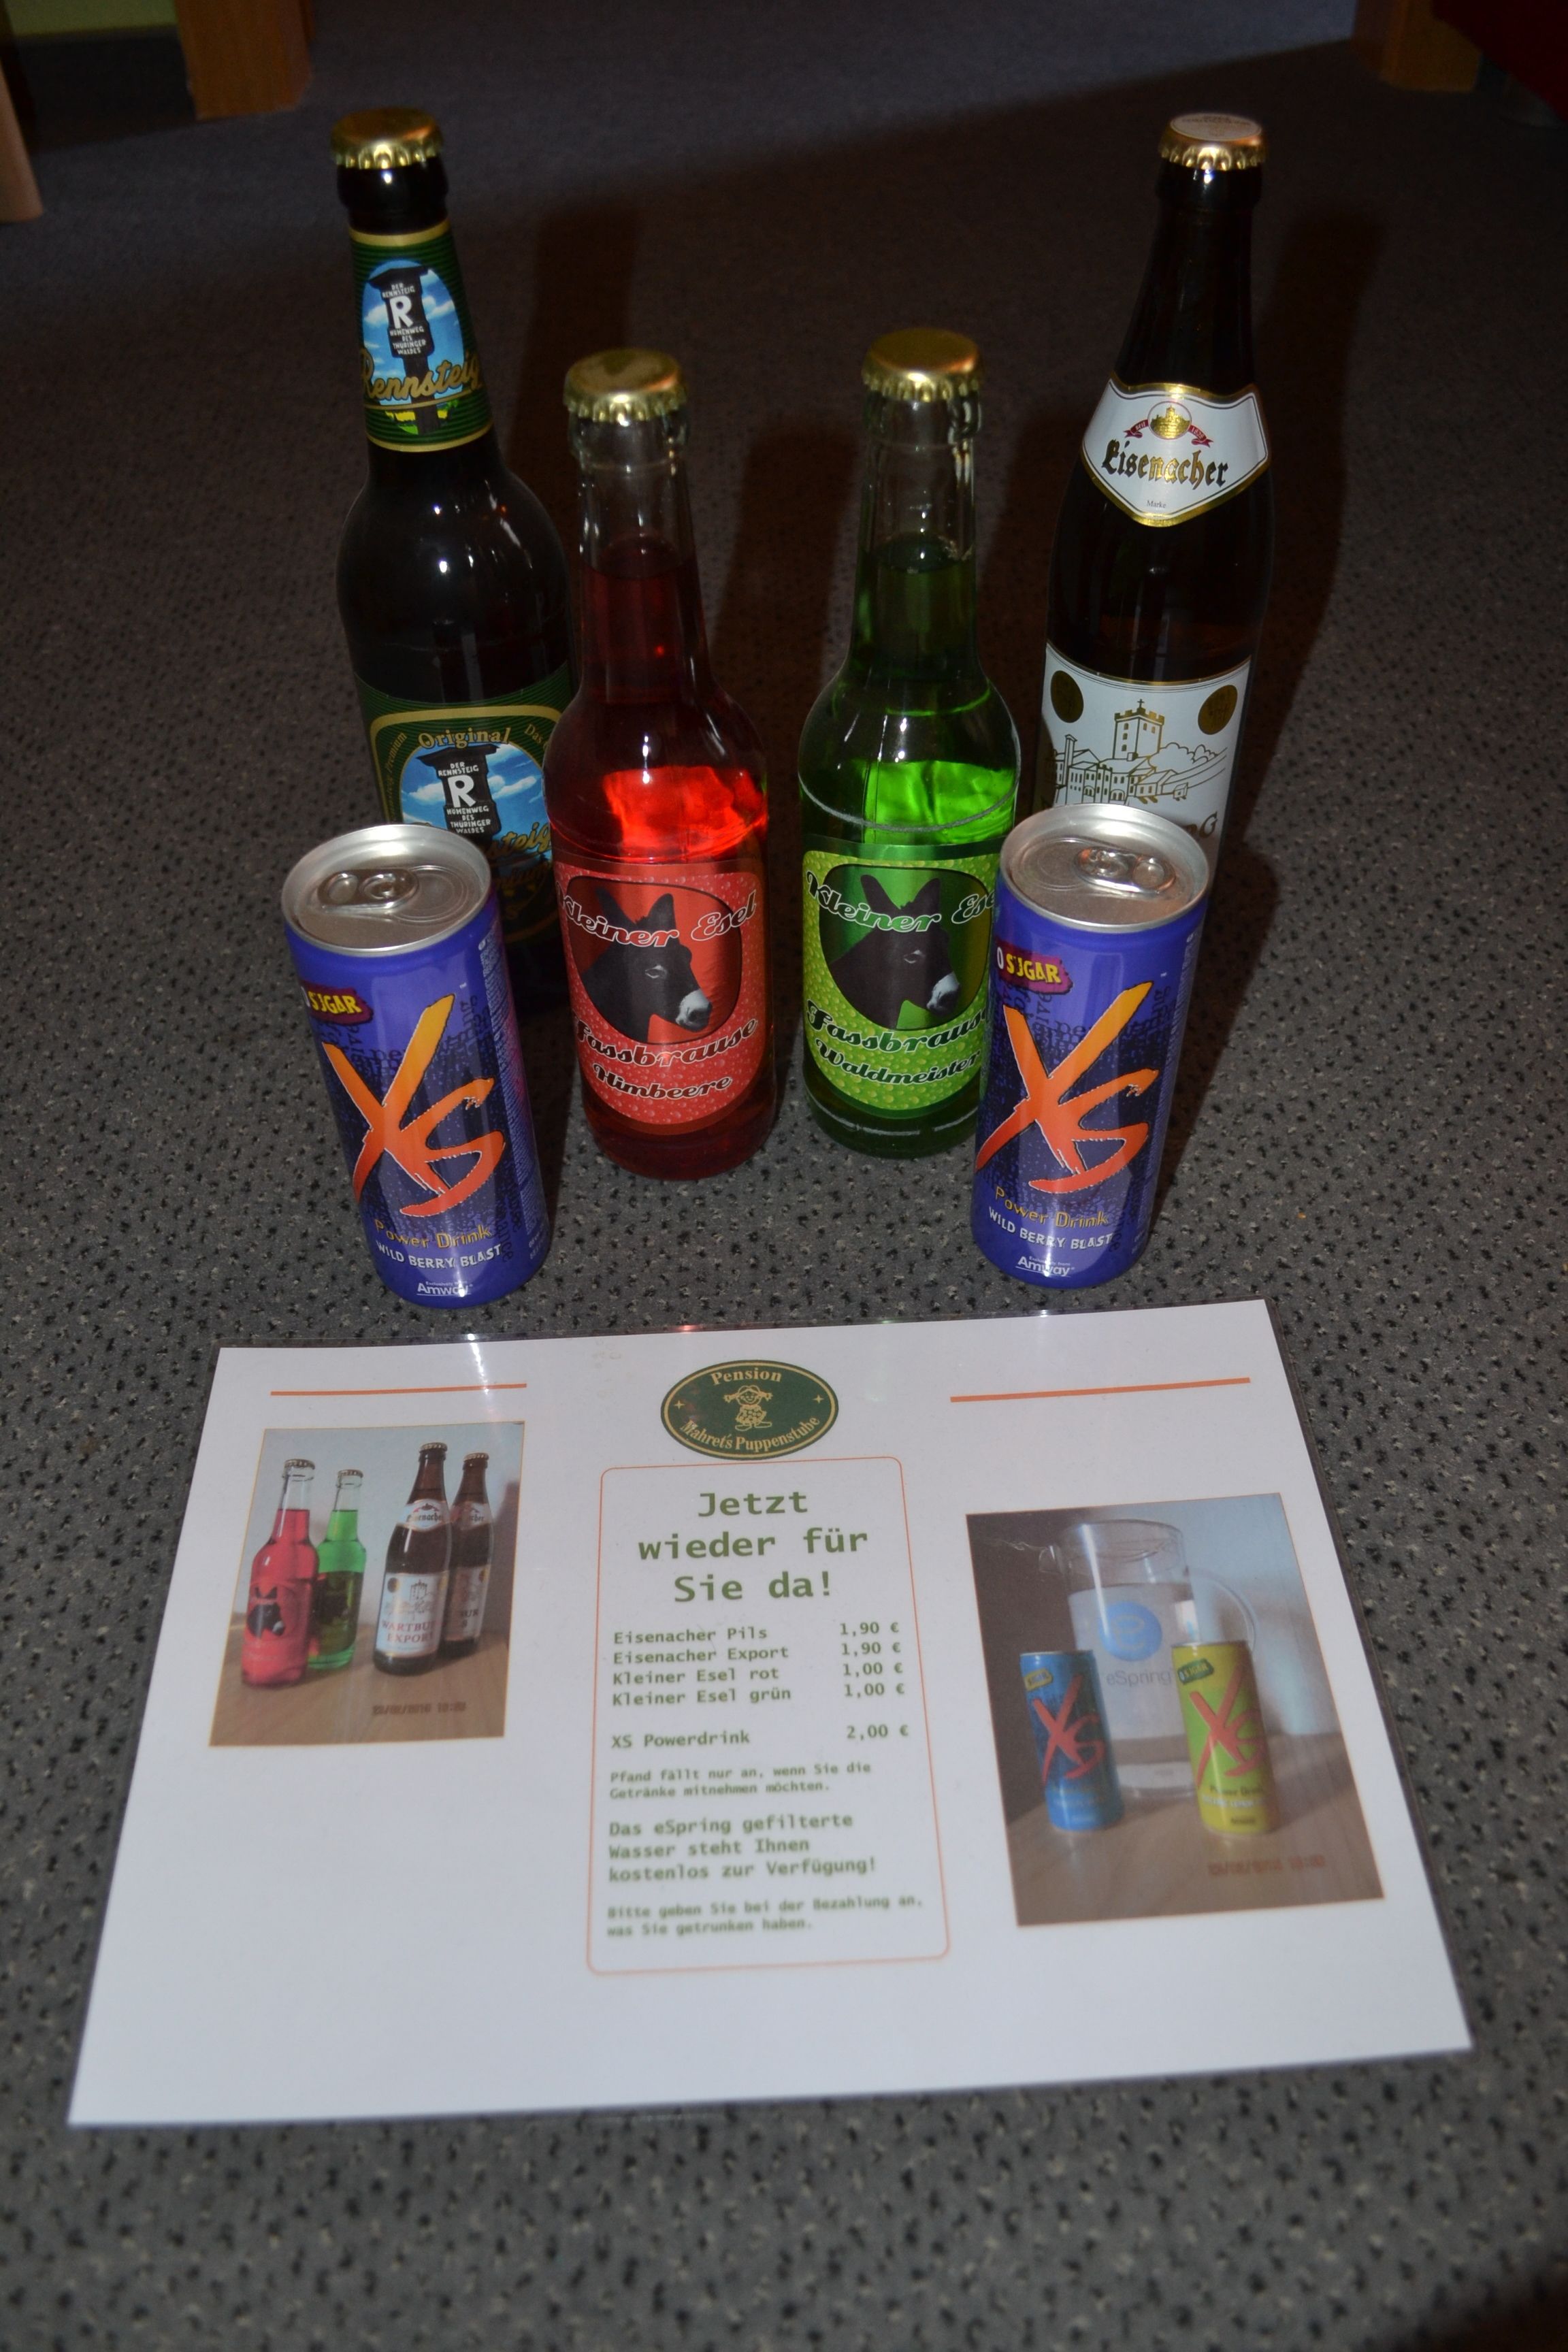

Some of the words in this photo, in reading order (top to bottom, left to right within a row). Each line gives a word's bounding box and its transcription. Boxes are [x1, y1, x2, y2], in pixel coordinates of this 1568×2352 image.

[389, 295, 414, 329] R
[360, 348, 480, 400] Rennsteig
[1101, 439, 1228, 490] Eisenacher
[1147, 500, 1166, 509] Marke
[419, 728, 511, 748] Original
[524, 724, 544, 743] Das
[438, 765, 479, 777] RENNSTEIG
[448, 774, 476, 808] R
[806, 870, 942, 932] Kleiner
[951, 890, 996, 924] Ese
[556, 881, 679, 947] Kleiner
[691, 889, 757, 942] Esel
[997, 947, 1004, 969] 0
[1006, 953, 1062, 983] SUGAR
[308, 991, 362, 1014] SUGAR
[577, 1015, 758, 1066] Fassbrause
[816, 1039, 981, 1085] Waldmeister
[593, 1063, 732, 1100] Himbeere
[975, 981, 1159, 1194] XS
[322, 994, 506, 1218] XS
[996, 1186, 1049, 1224] Power
[1056, 1211, 1109, 1229] Drink
[375, 1220, 429, 1247] Power
[436, 1224, 491, 1248] Drink
[989, 1206, 1015, 1233] WILD
[1019, 1228, 1066, 1247] BERRY
[1071, 1232, 1113, 1250] BLAST
[376, 1241, 404, 1262] WILD
[408, 1255, 455, 1269] BERRY
[461, 1244, 501, 1267] BLAST
[711, 1367, 782, 1386] Pension
[736, 1417, 820, 1452] Puppenstube
[698, 1492, 807, 1517] Jetzt
[638, 1531, 775, 1560] wieder
[803, 1527, 867, 1553] für
[674, 1574, 742, 1602] Sie
[769, 1571, 830, 1599] da!
[615, 1629, 716, 1644] Eisenacher
[728, 1627, 767, 1639] Pils
[841, 1622, 879, 1636] 1,90
[890, 1622, 898, 1633] €
[614, 1650, 716, 1664] Eisenacher
[728, 1647, 788, 1662] Export
[843, 1642, 881, 1656] 1,90
[892, 1642, 900, 1652] €
[613, 1671, 685, 1684] Kleiner
[697, 1668, 734, 1682] Esel
[750, 1668, 779, 1679] rot
[844, 1663, 883, 1677] 1,00
[894, 1663, 902, 1673] €
[1106, 1670, 1171, 1687] eSpring
[613, 1692, 685, 1705] Kleiner
[697, 1688, 735, 1703] Esel
[750, 1688, 791, 1703] grün
[845, 1683, 885, 1698] 1,00
[896, 1683, 904, 1694] €
[612, 1735, 632, 1748] XS
[644, 1730, 749, 1747] Powerdrink
[847, 1725, 888, 1740] 2,00
[900, 1725, 908, 1736] €
[1033, 1673, 1106, 1786] XS
[611, 1771, 651, 1782] Pfand
[661, 1769, 698, 1780] fällt
[708, 1770, 732, 1779] nur
[741, 1769, 762, 1778] an,
[773, 1767, 806, 1776] wenn
[814, 1764, 838, 1774] Sie
[847, 1762, 870, 1773] die
[610, 1786, 675, 1799] Getränke
[684, 1784, 757, 1796] mitnehmen
[766, 1781, 828, 1793] möchten.
[610, 1823, 641, 1836] Das
[654, 1818, 731, 1836] eSpring
[742, 1814, 852, 1834] gefilterte
[609, 1846, 675, 1859] Wasser
[689, 1840, 740, 1856] steht
[756, 1838, 809, 1852] Ihnen
[609, 1864, 708, 1882] kostenlos
[722, 1865, 754, 1878] zur
[766, 1857, 874, 1876] Verfügung!
[608, 1907, 650, 1918] Bitte
[659, 1905, 701, 1919] geben
[710, 1903, 736, 1914] Sie
[745, 1901, 768, 1913] bei
[779, 1901, 804, 1912] der
[813, 1896, 889, 1910] Bezahlung
[608, 1927, 632, 1936] was
[642, 1923, 667, 1935] Sie
[676, 1920, 753, 1936] getrunken
[762, 1918, 810, 1930] haben.
